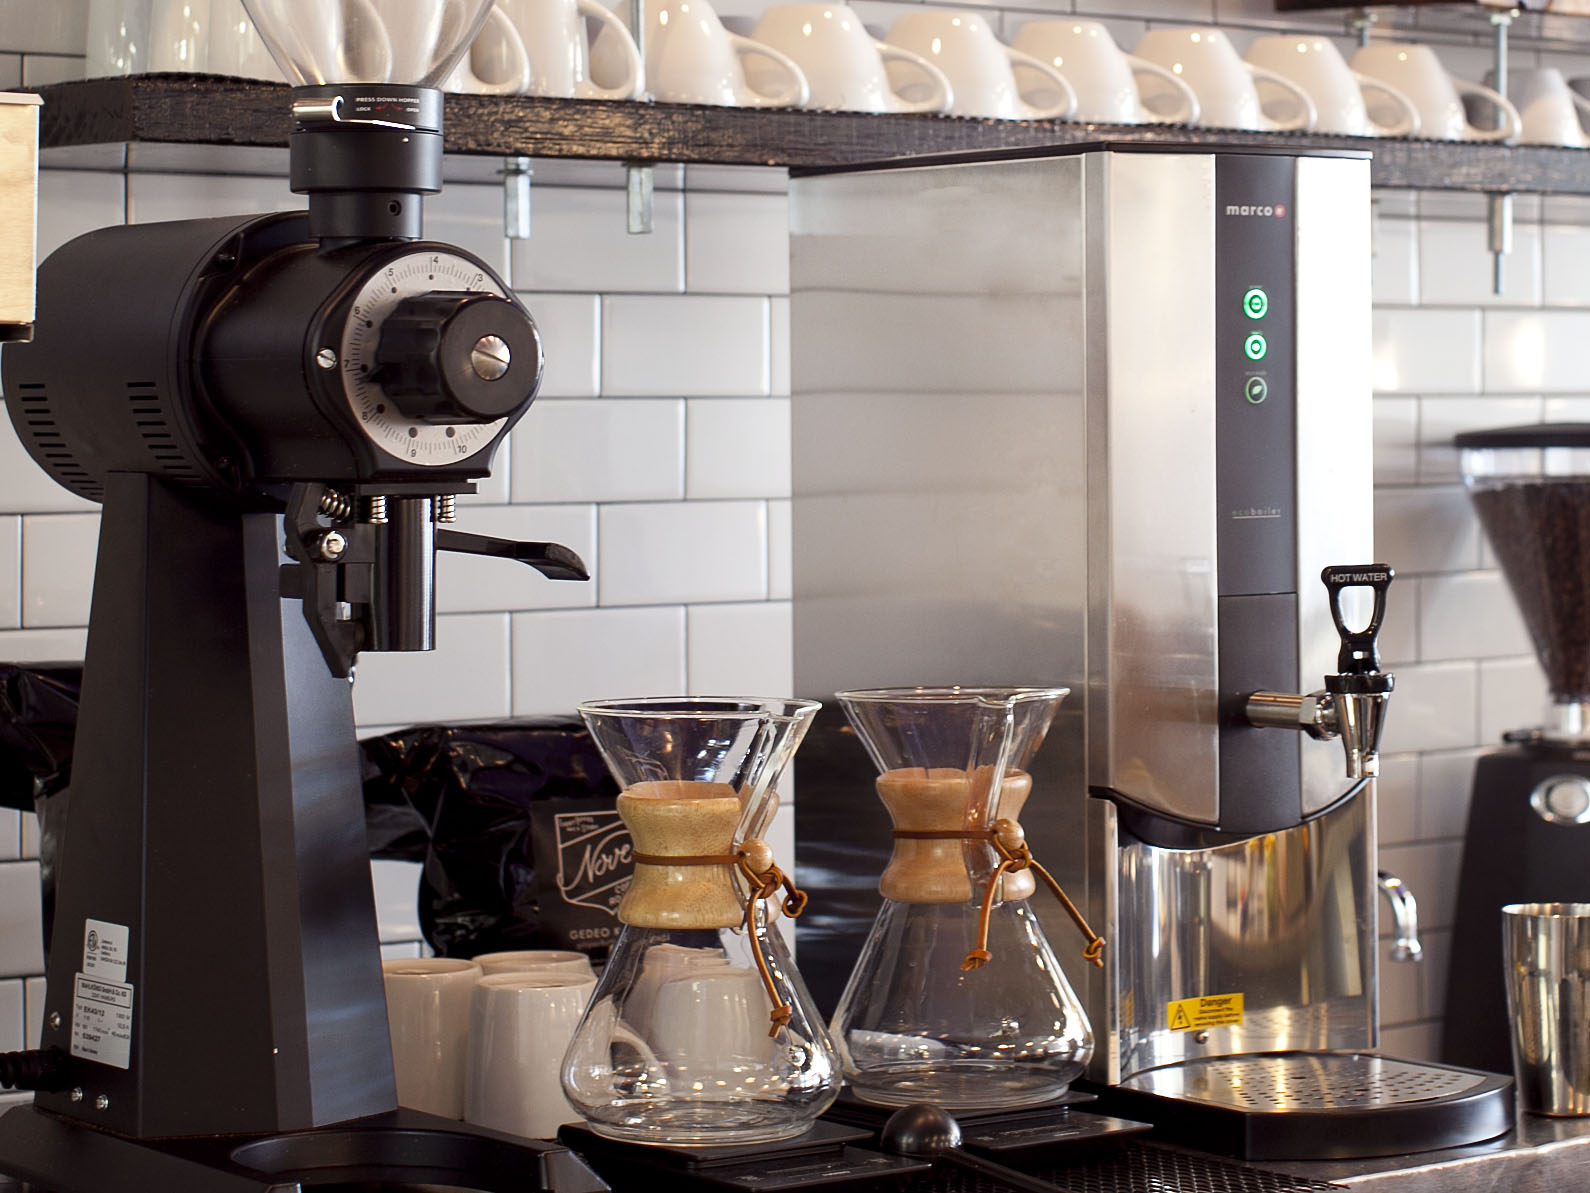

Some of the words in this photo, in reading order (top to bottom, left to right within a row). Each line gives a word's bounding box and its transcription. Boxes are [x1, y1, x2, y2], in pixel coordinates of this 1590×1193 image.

[1226, 205, 1273, 217] marco
[433, 256, 439, 264] 4
[388, 268, 394, 277] 5
[477, 273, 483, 282] 3
[354, 306, 360, 315] 6
[344, 359, 350, 368] 7
[362, 411, 368, 420] 8
[411, 448, 417, 457] 9
[457, 445, 467, 454] 10
[1331, 573, 1352, 583] HOT
[1352, 572, 1388, 582] WATER
